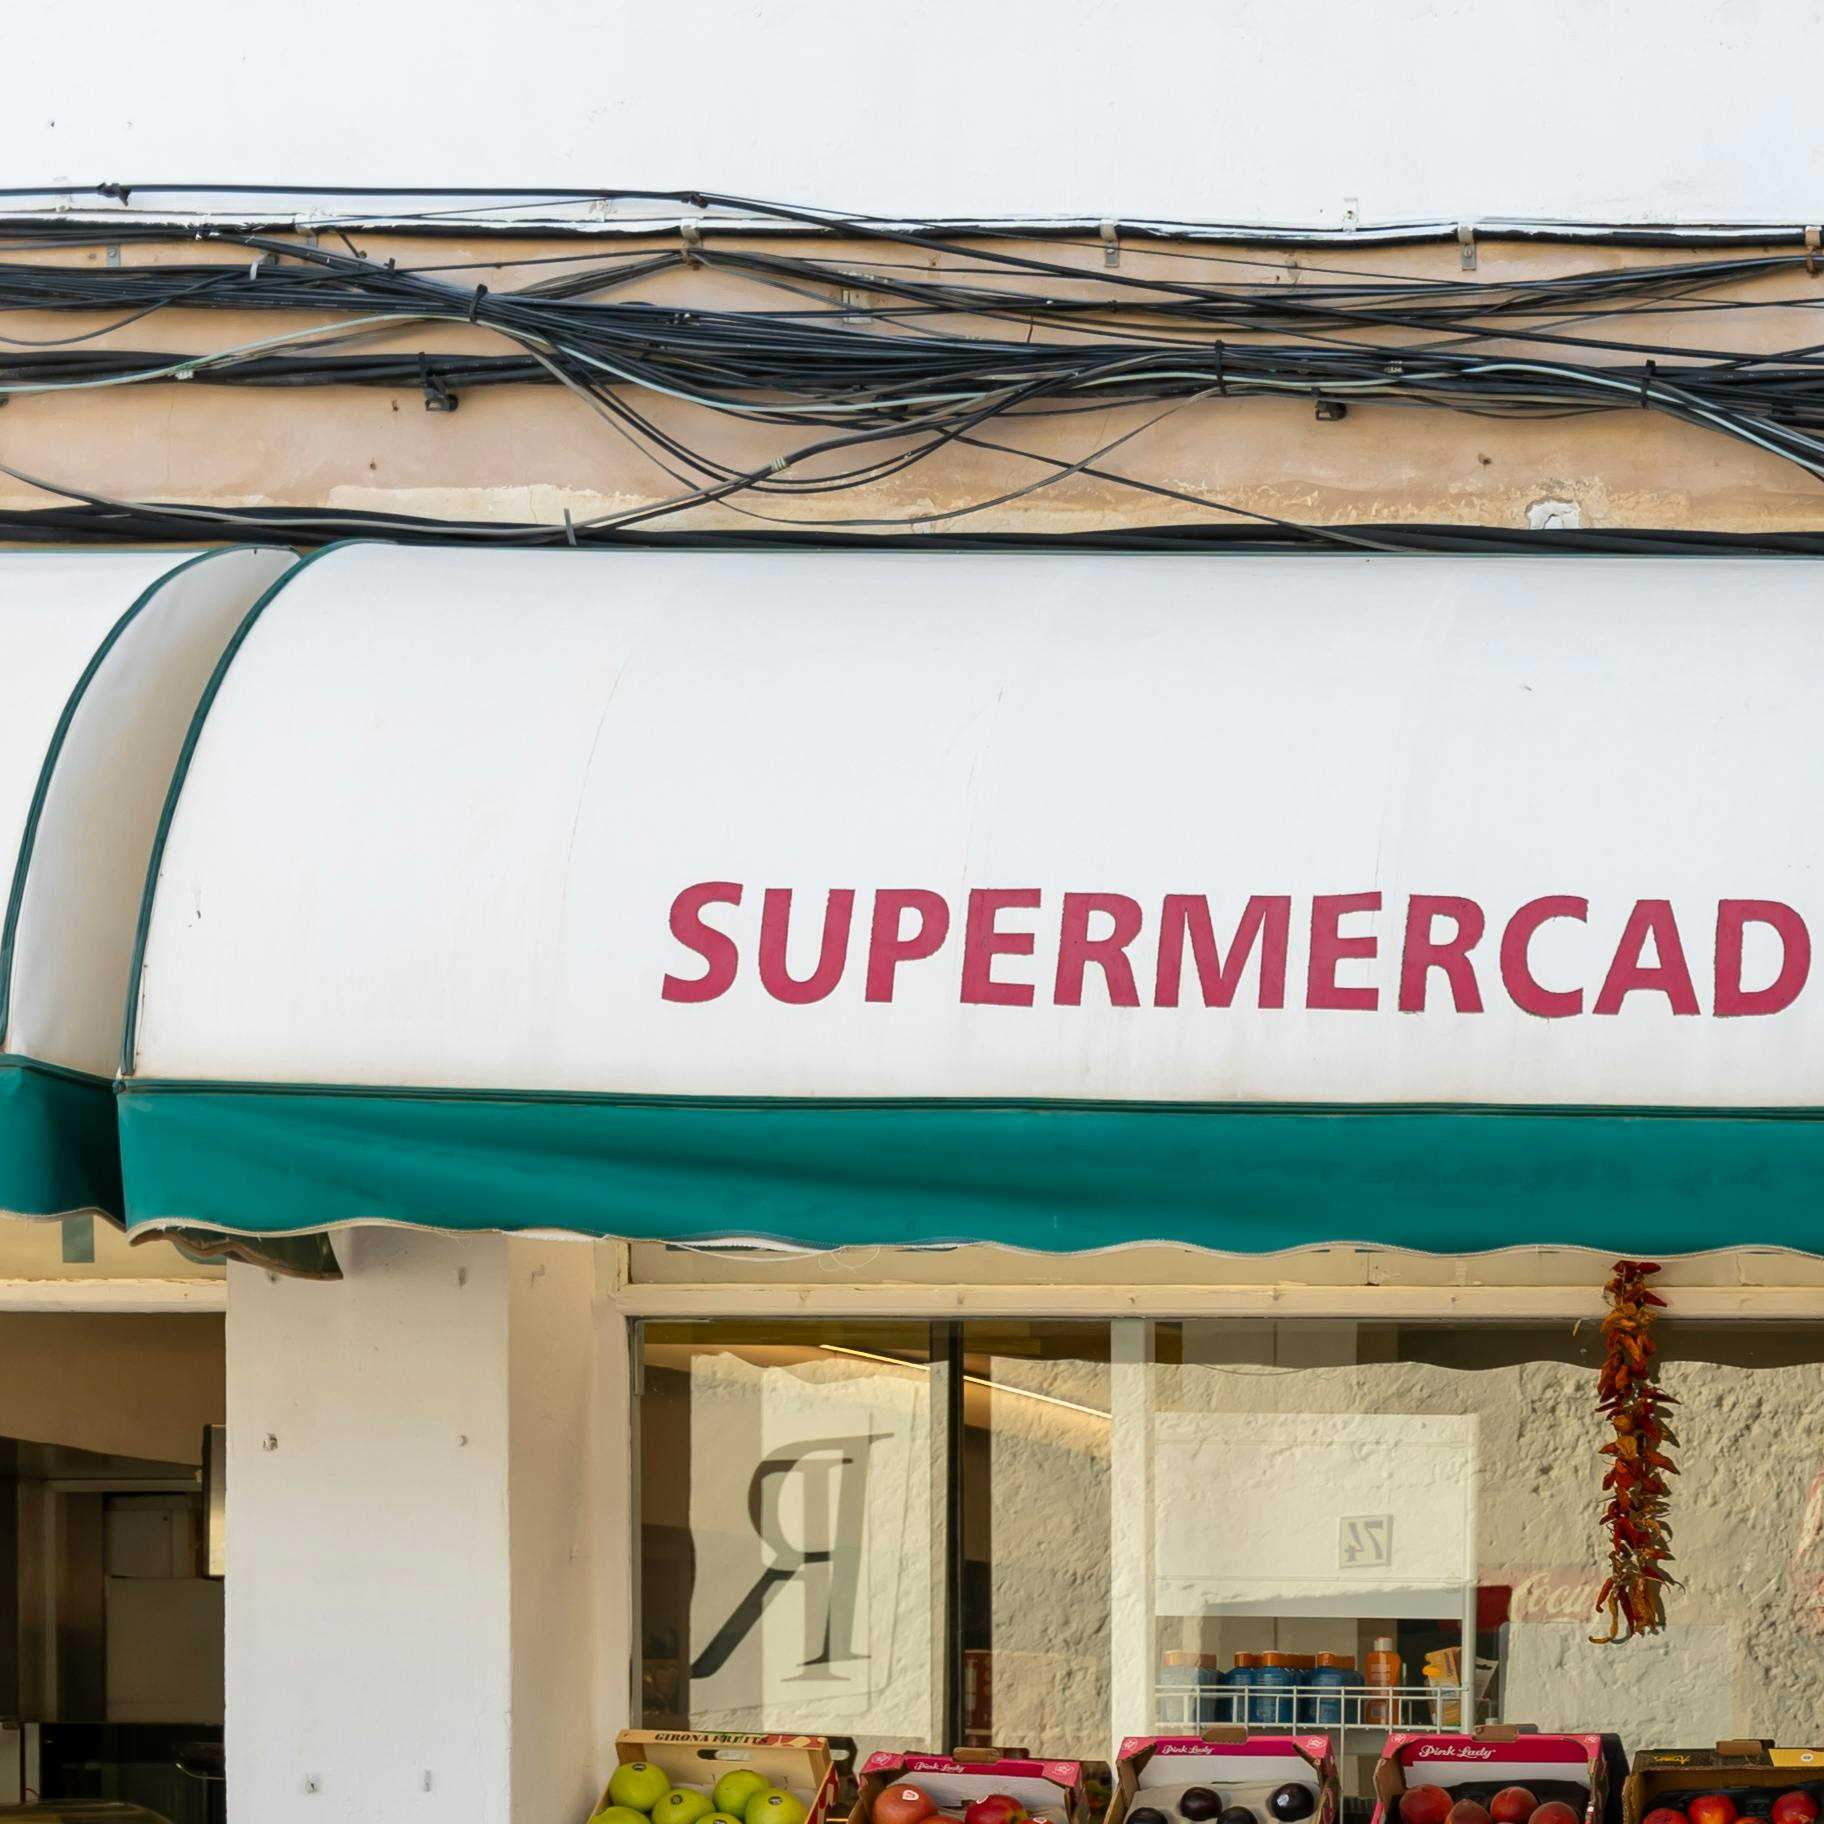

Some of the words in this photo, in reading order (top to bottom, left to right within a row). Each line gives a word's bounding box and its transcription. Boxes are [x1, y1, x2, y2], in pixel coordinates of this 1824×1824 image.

[654, 1732, 710, 1743] GIRONA
[713, 1733, 769, 1745] FRUITS
[1418, 1744, 1456, 1758] Pink
[1457, 1745, 1496, 1760] Lady
